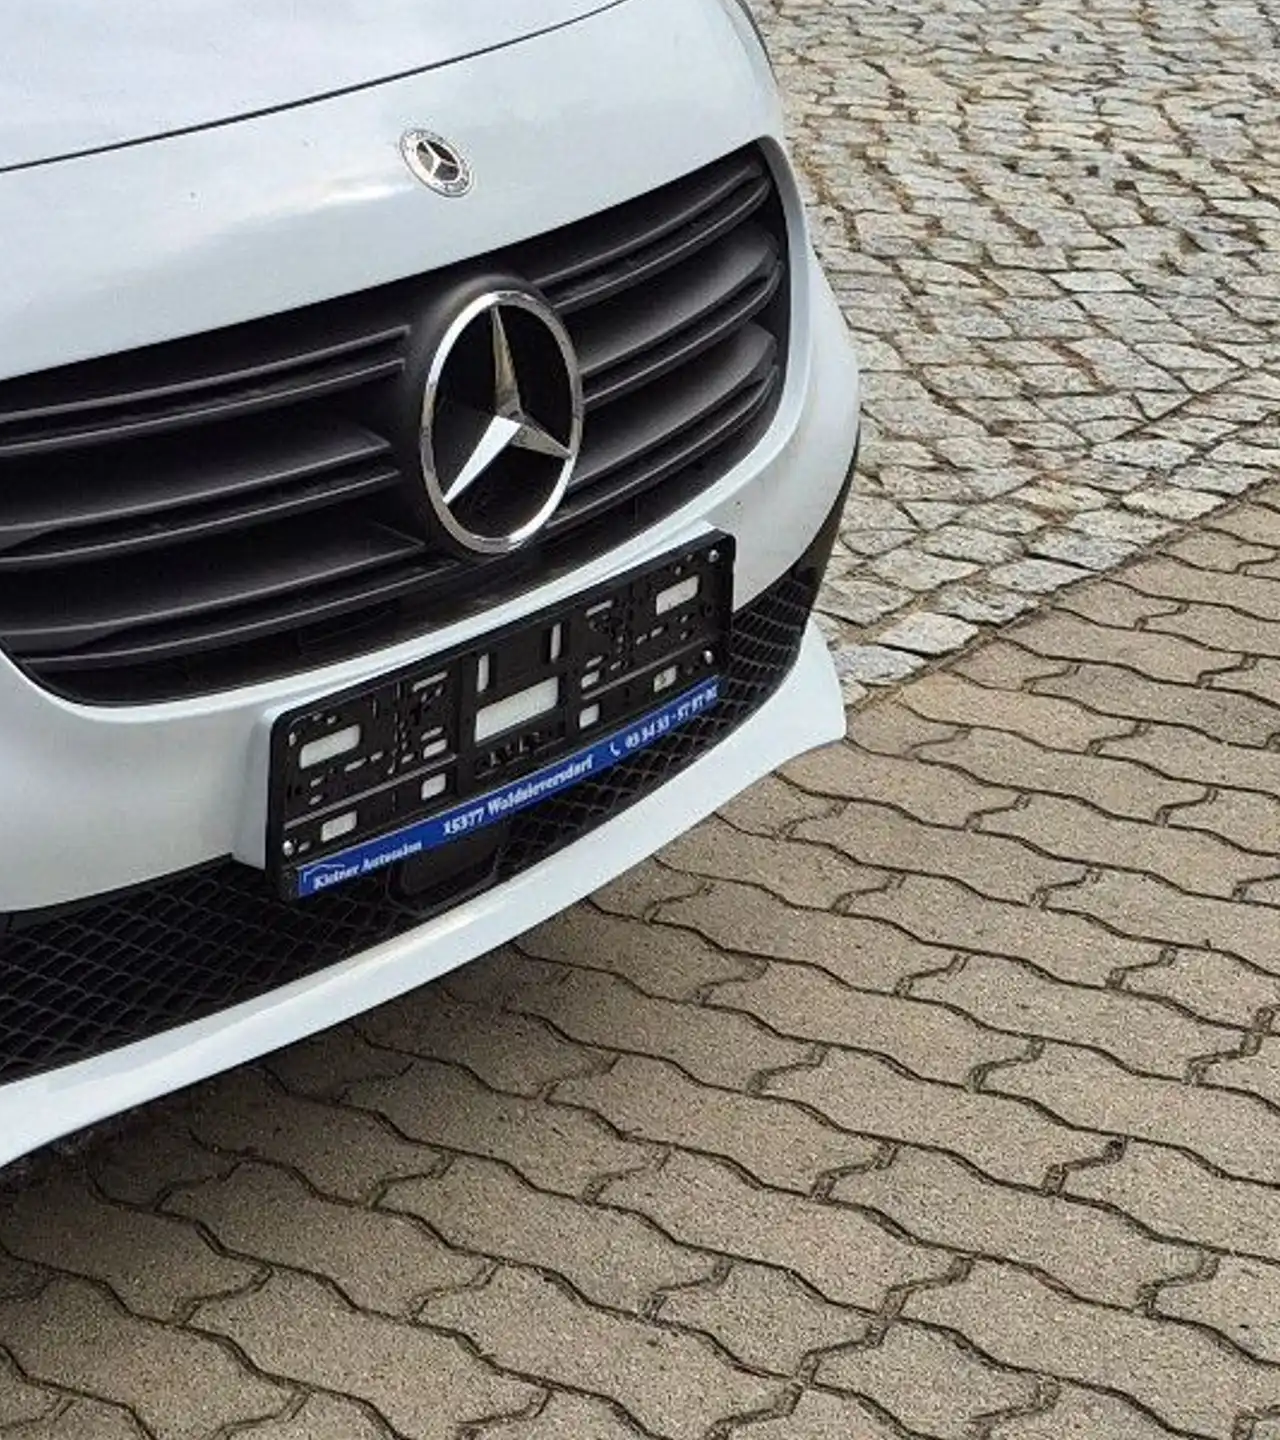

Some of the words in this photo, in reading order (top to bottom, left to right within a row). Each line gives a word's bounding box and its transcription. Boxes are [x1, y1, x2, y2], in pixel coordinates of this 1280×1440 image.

[313, 863, 360, 891] Kleiner
[361, 842, 423, 873] Autosalon
[443, 806, 485, 836] 15377
